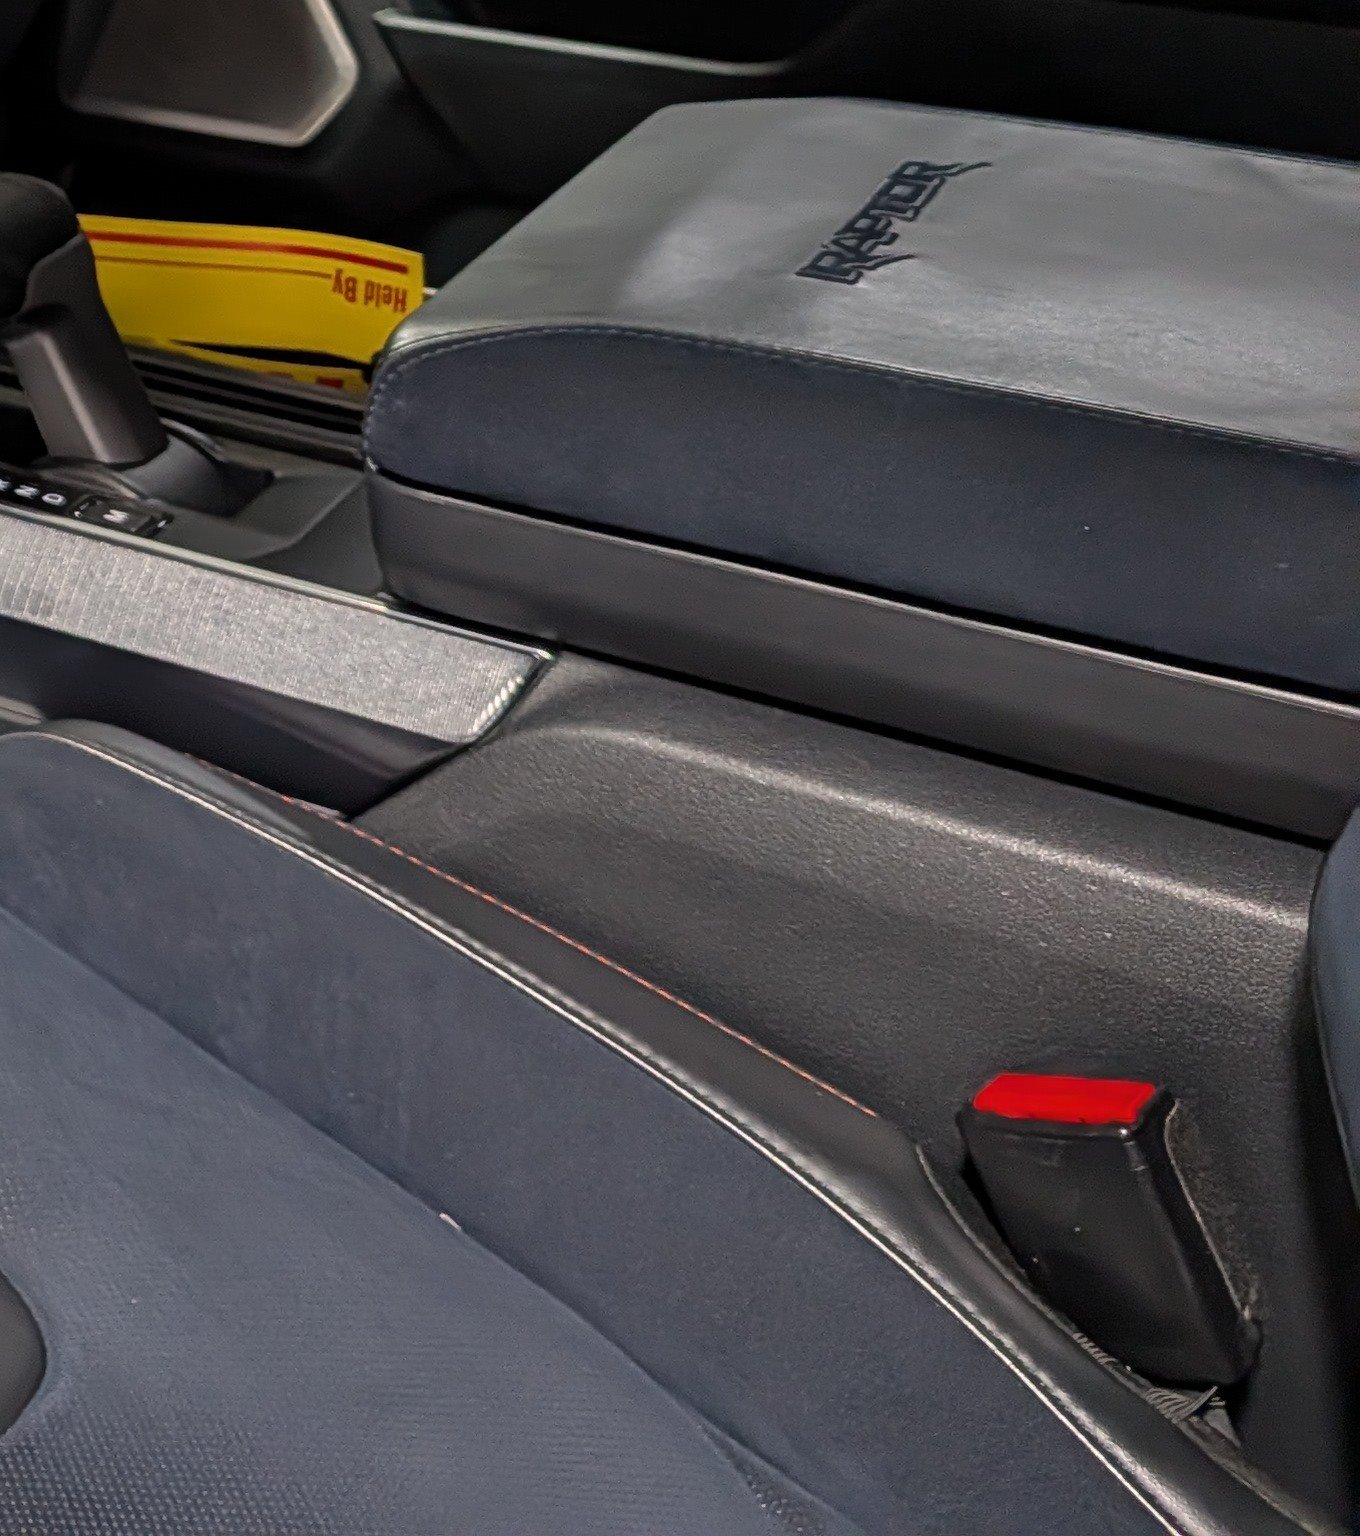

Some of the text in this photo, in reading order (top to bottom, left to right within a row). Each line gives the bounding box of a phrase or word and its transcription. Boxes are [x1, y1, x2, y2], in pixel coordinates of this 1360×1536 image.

[794, 160, 993, 285] RAPTOR
[332, 268, 408, 313] Held By
[13, 484, 40, 499] N
[41, 492, 67, 507] D
[102, 508, 130, 524] M
